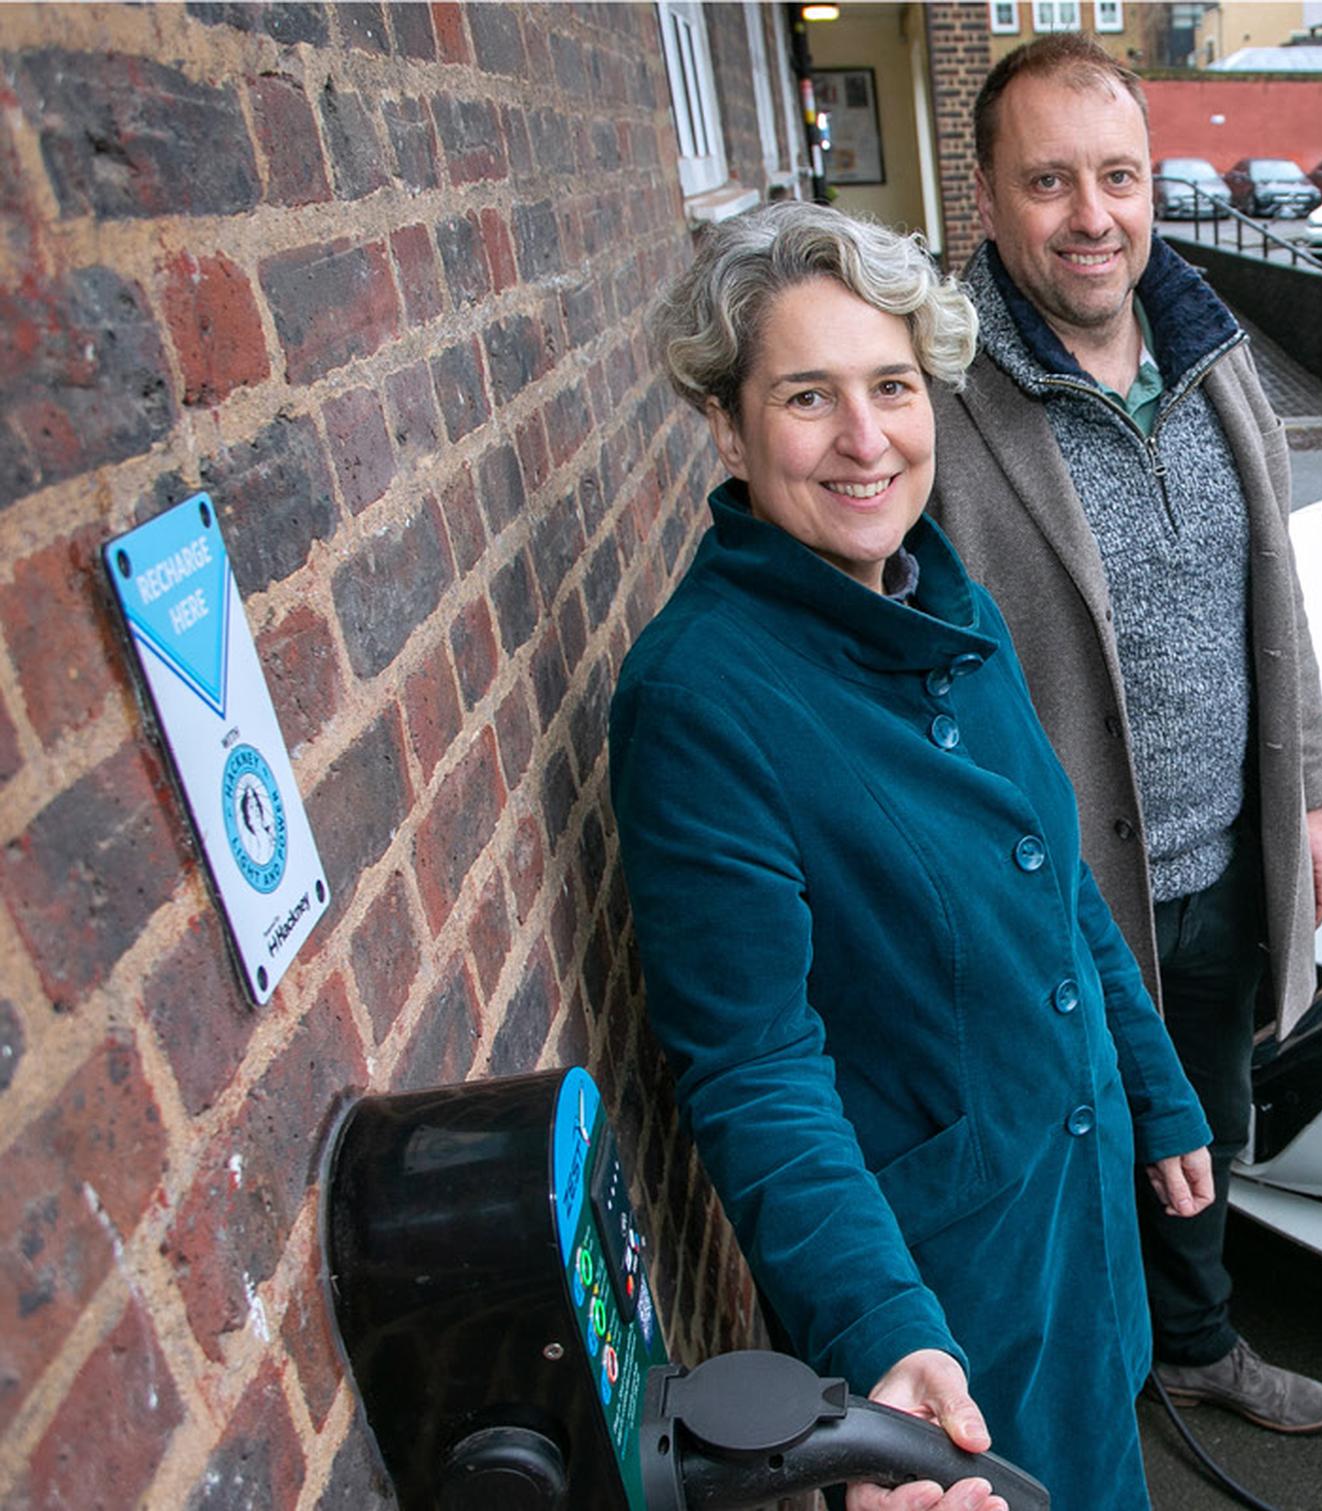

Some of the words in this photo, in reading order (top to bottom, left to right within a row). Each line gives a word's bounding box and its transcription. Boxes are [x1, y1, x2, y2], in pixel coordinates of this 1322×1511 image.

[136, 535, 212, 605] RECHARGE
[168, 588, 209, 635] HERE
[225, 752, 259, 798] HACKNEY
